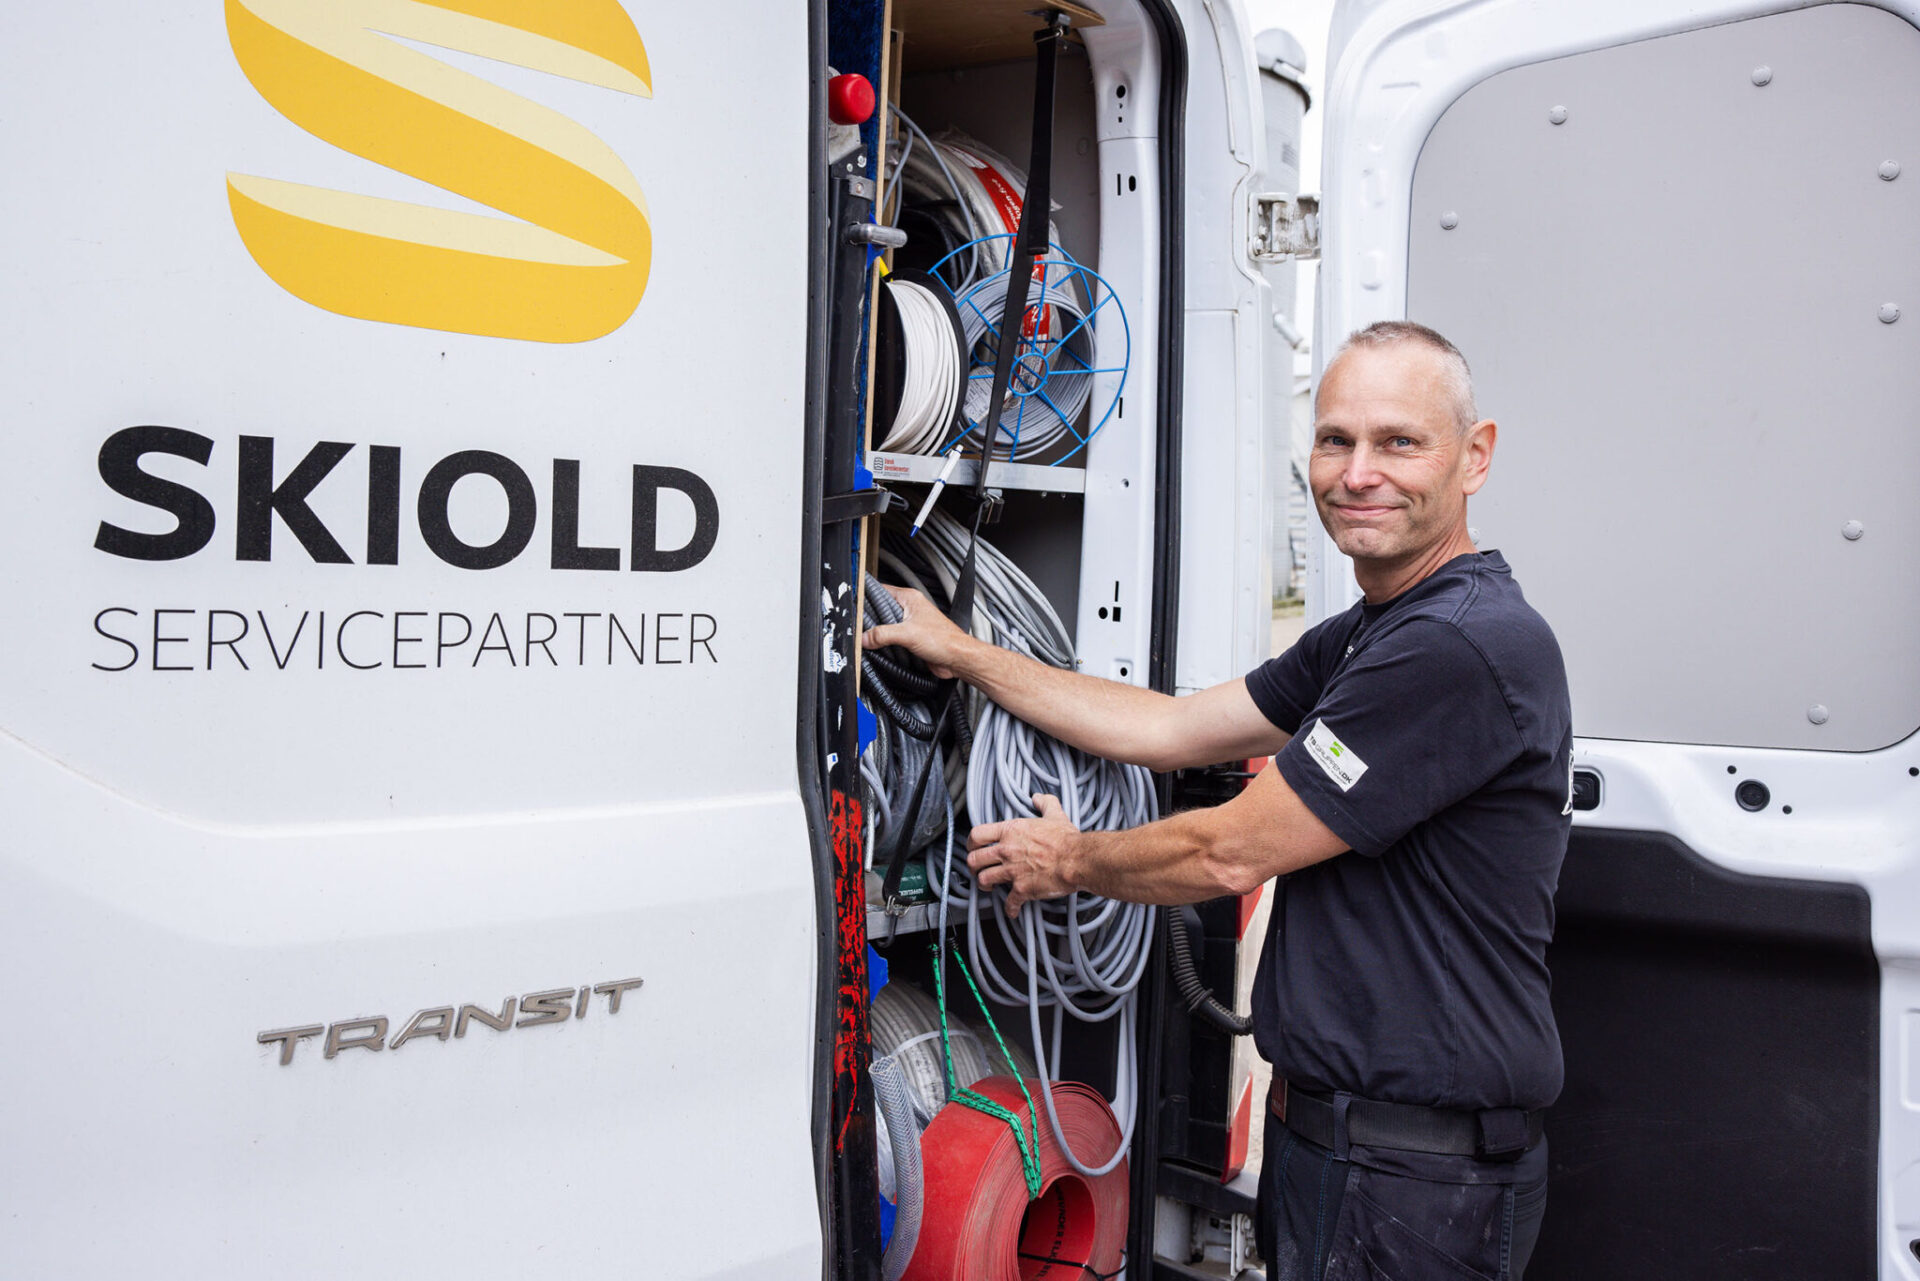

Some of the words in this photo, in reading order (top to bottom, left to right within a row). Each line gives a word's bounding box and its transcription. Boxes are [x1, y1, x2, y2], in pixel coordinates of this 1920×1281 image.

[94, 426, 720, 572] SKIOLD
[92, 607, 718, 672] SERVICEPARTNER
[257, 977, 644, 1067] TRANSIT
